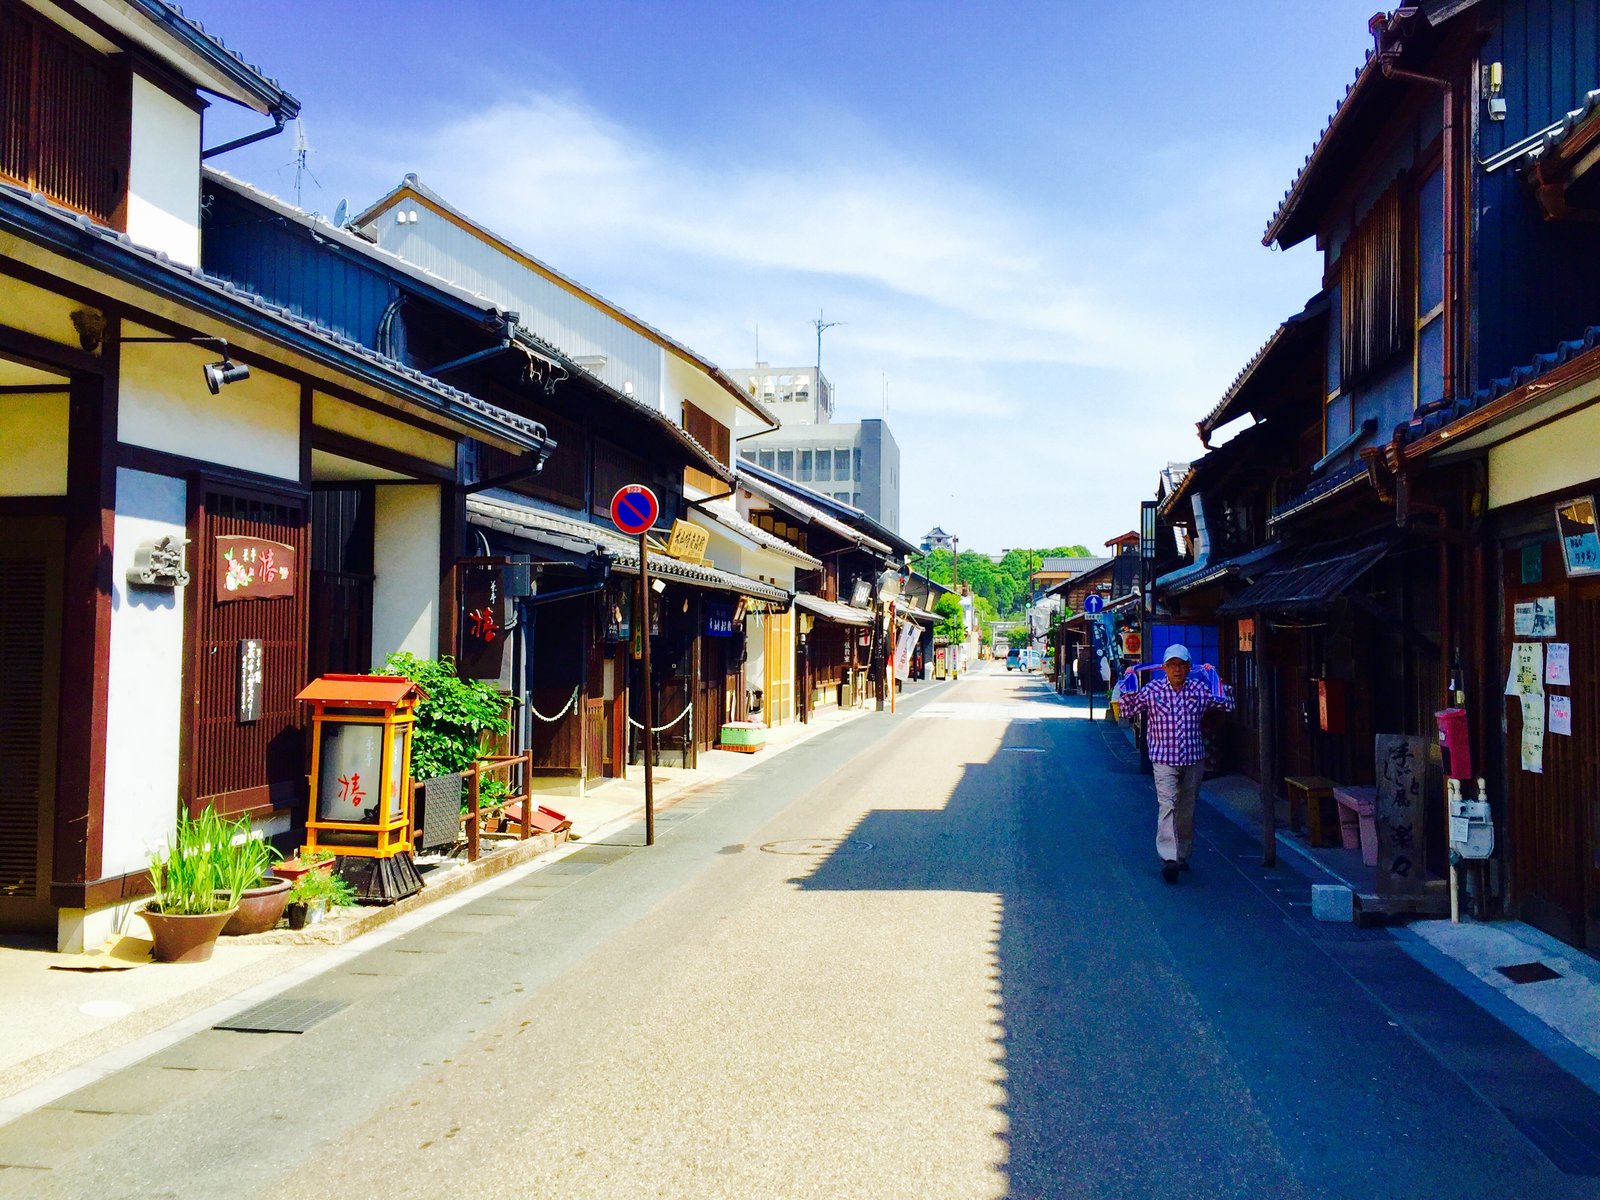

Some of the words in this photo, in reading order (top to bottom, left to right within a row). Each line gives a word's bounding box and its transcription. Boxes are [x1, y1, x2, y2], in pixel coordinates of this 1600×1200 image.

[258, 548, 279, 583] 椿
[468, 606, 500, 643] 椿
[337, 772, 367, 807] 椿
